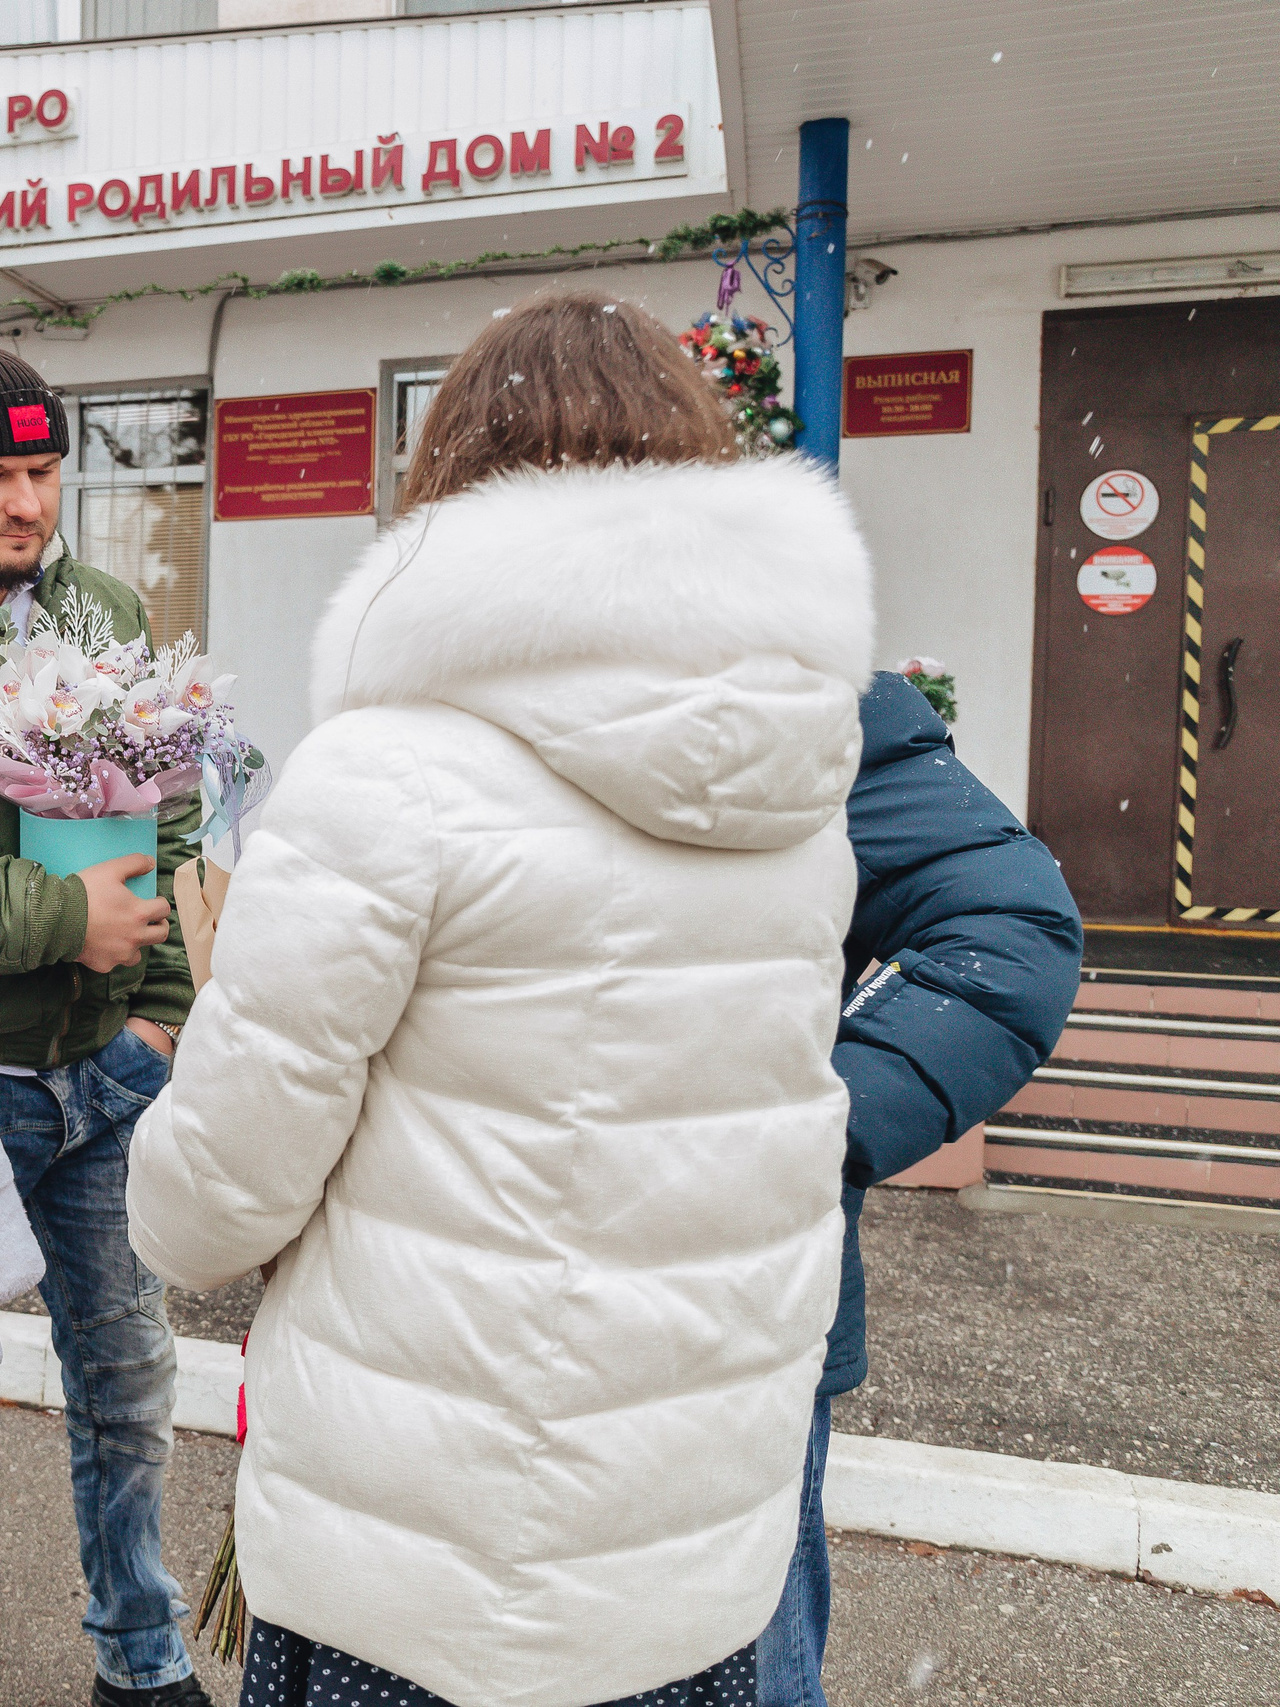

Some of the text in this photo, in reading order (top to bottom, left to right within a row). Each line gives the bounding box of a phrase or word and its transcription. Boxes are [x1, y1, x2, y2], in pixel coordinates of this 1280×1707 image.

[7, 89, 69, 134] РО
[67, 132, 405, 224] РОДИЛЬНЫЙ
[421, 129, 552, 192] ДОМ
[575, 121, 636, 170] №
[654, 114, 685, 160] 2
[855, 369, 961, 390] ВЫПИСНАЯ
[16, 416, 44, 428] HUGO
[841, 986, 877, 1018] Fashion
